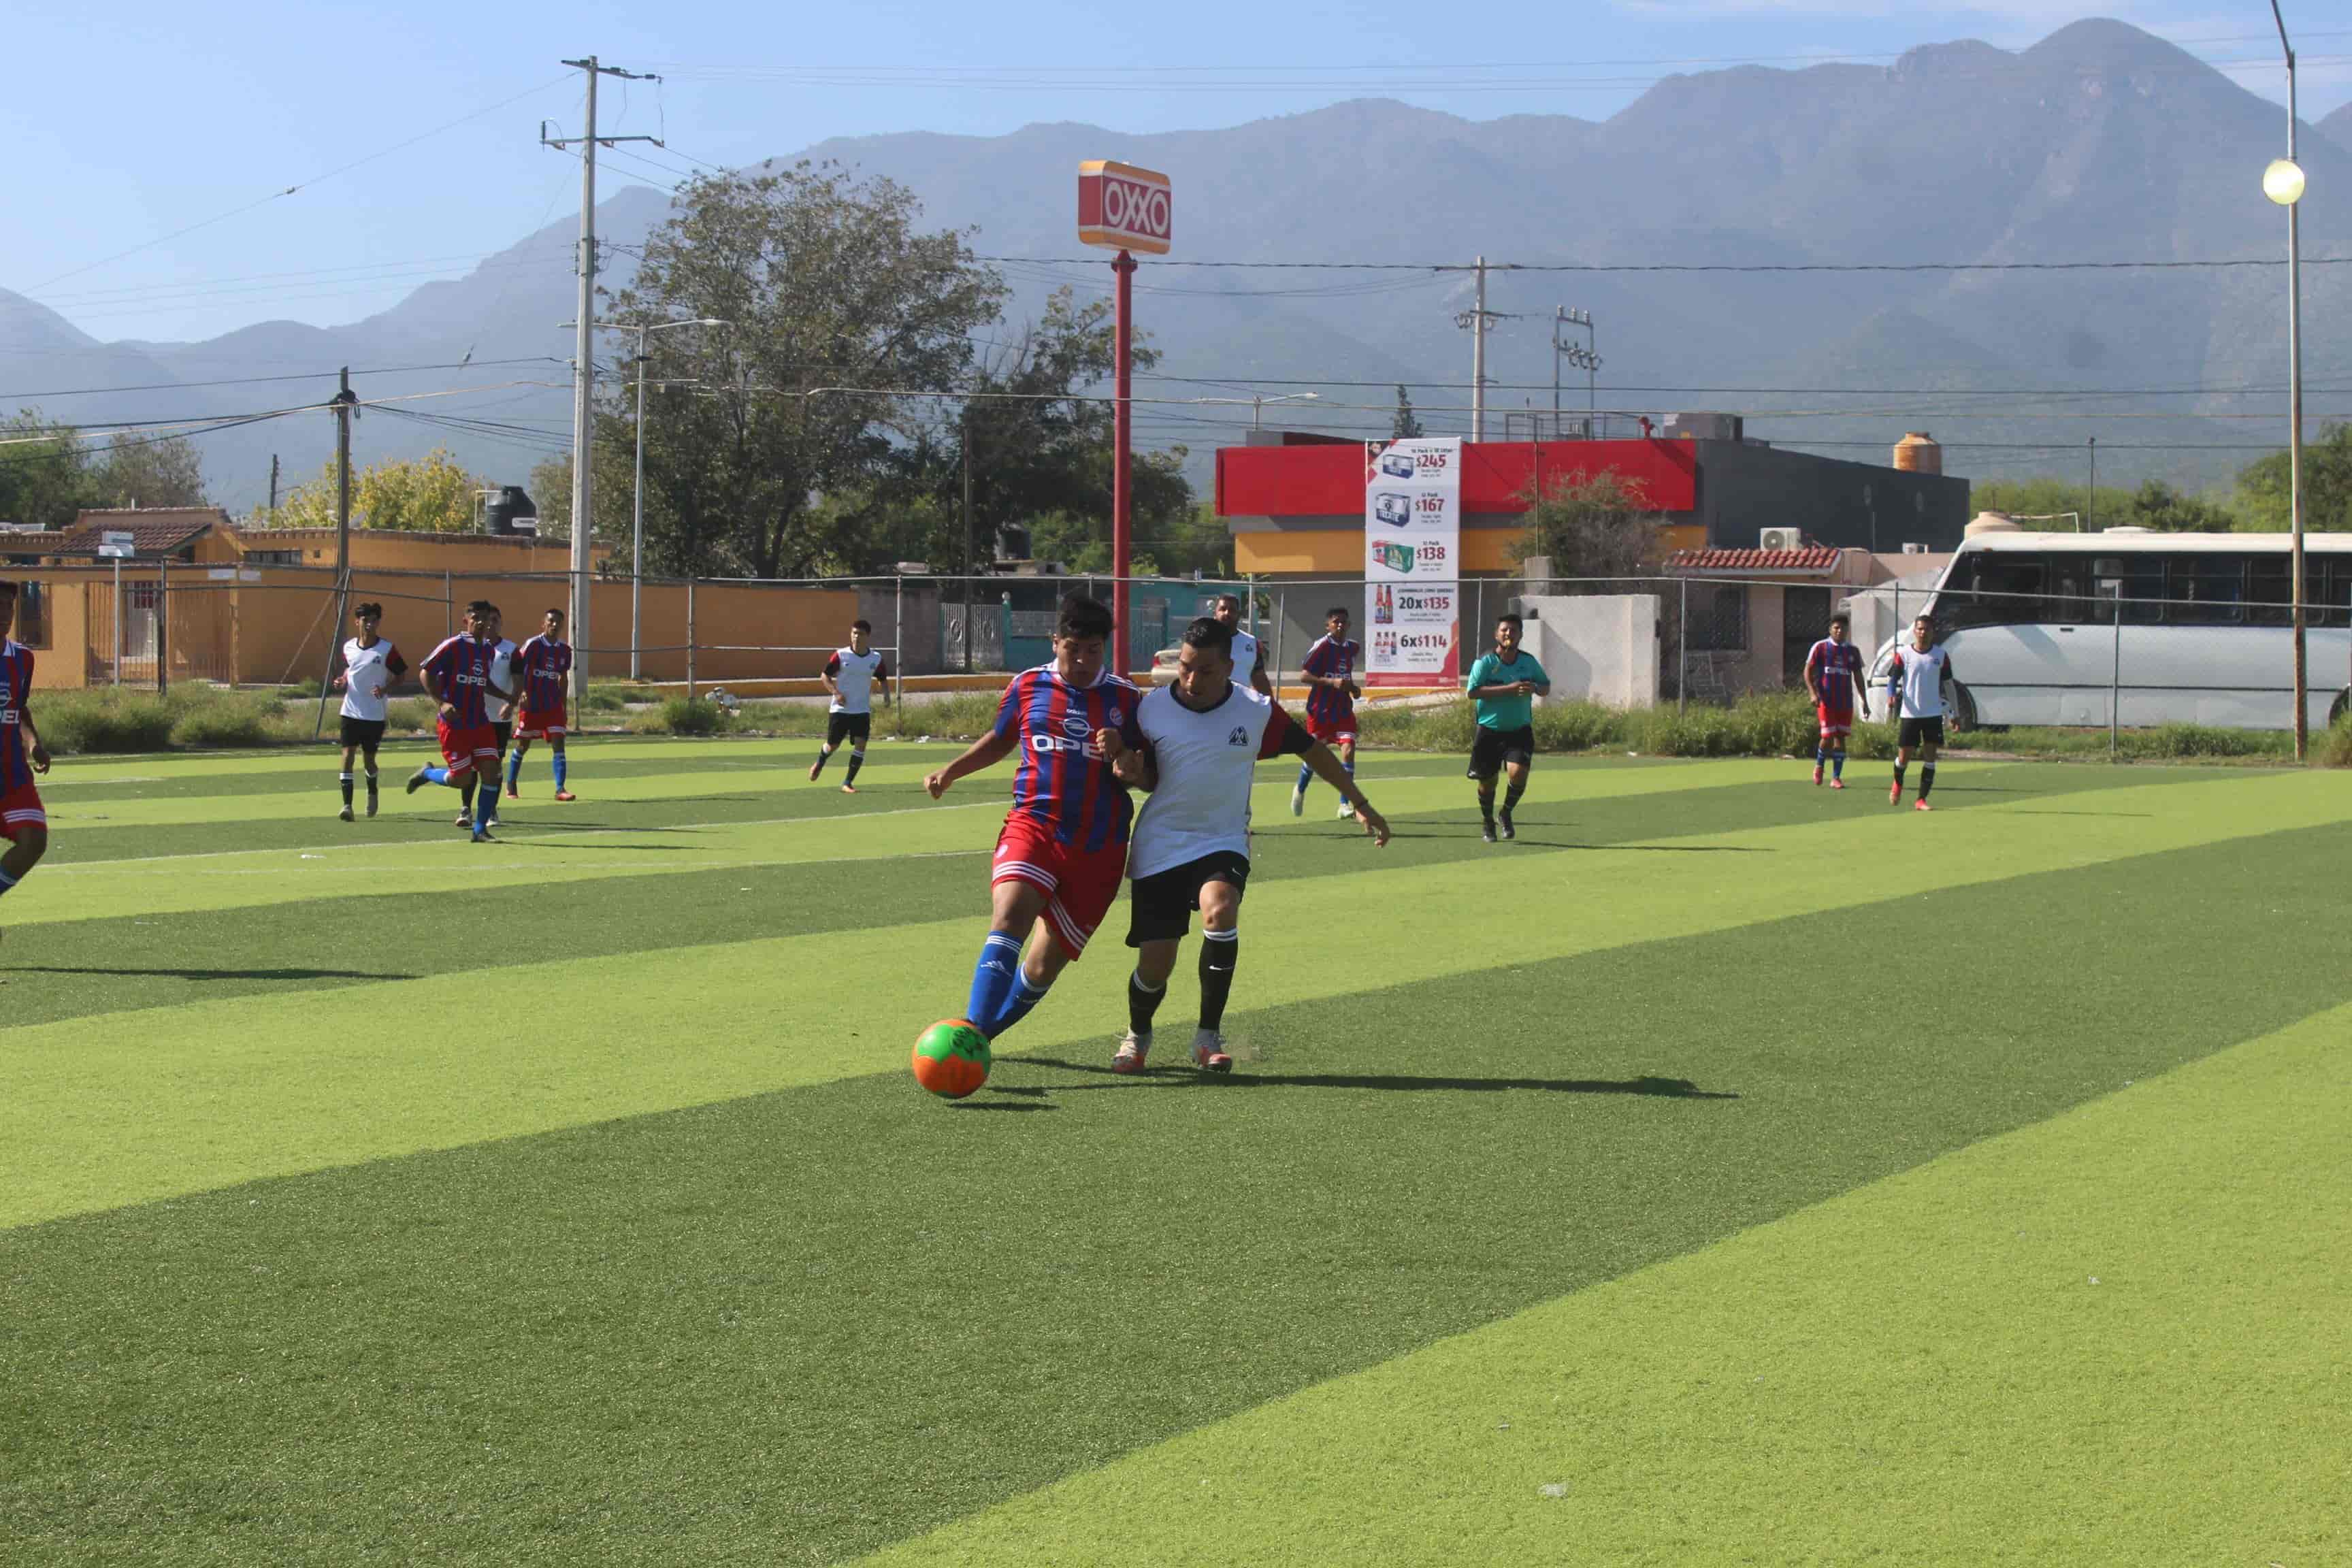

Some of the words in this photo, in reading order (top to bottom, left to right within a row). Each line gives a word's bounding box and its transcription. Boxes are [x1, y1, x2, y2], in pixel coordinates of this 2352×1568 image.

[1105, 181, 1169, 235] OXXO
[1416, 454, 1446, 468] $245
[1415, 497, 1444, 512] $167
[1416, 546, 1445, 560] $138
[1399, 596, 1450, 609] 20x$135
[1401, 634, 1447, 647] 6x$114
[1032, 734, 1105, 762] OPE
